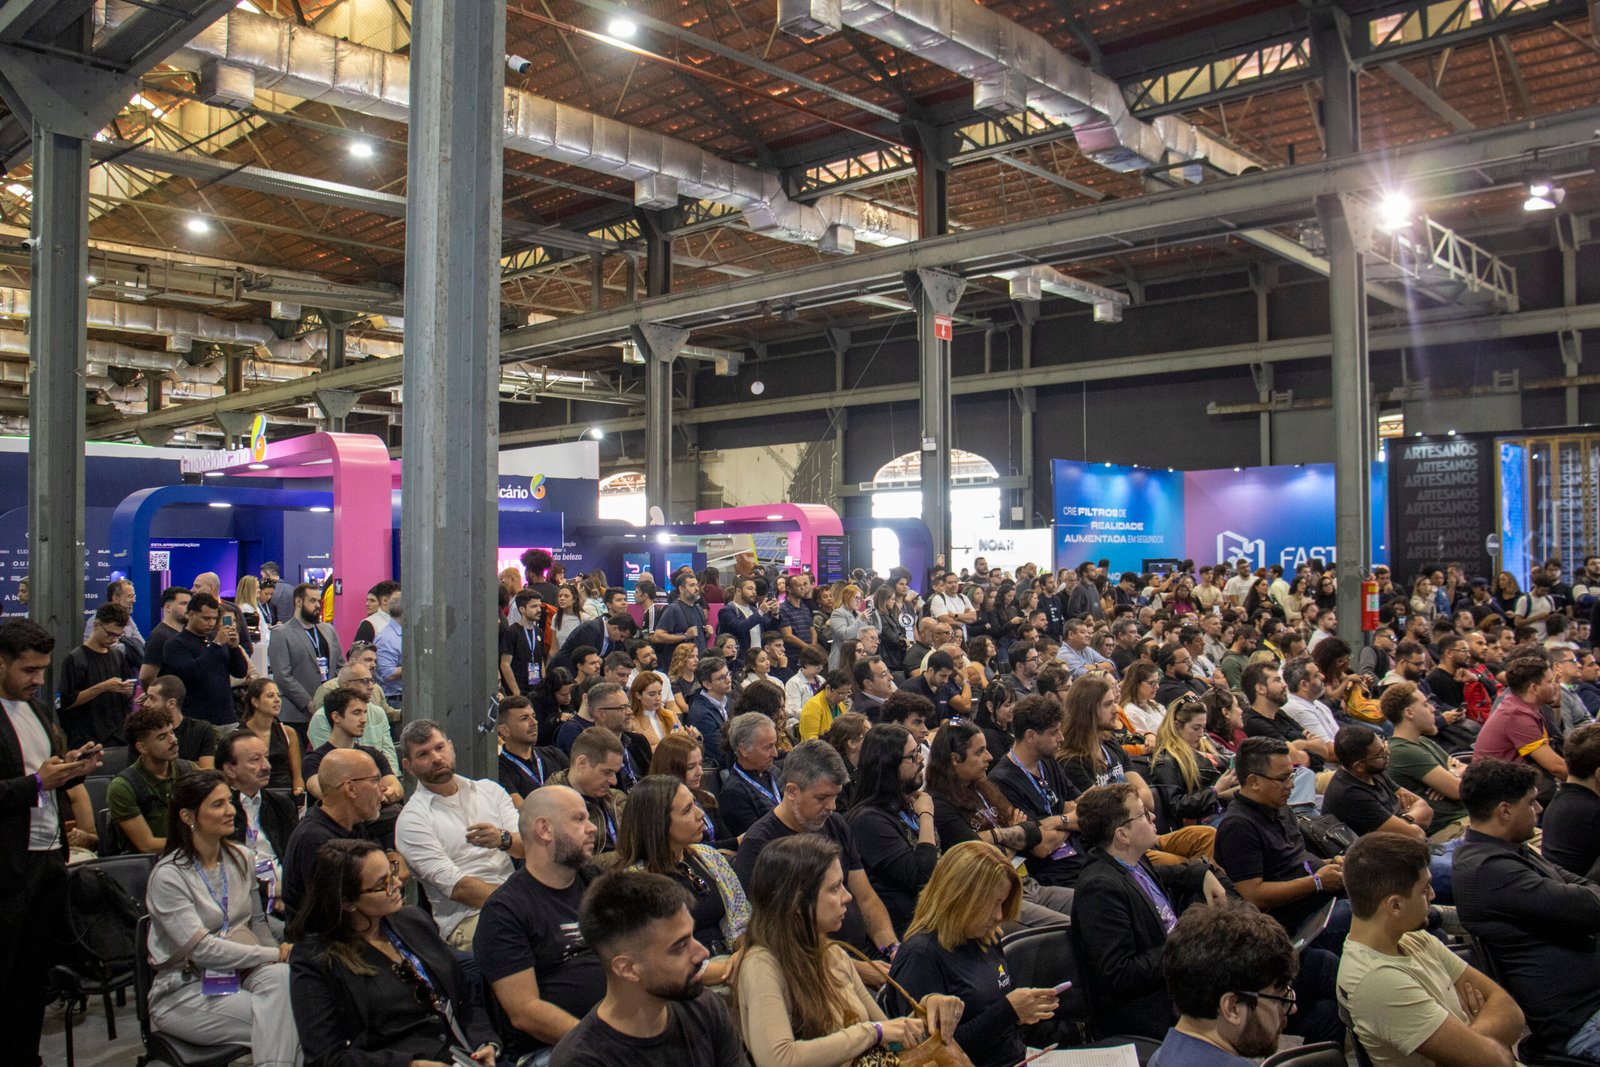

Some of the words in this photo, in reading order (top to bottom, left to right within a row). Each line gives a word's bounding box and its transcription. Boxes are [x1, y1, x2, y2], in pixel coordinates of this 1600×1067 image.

[1404, 443, 1478, 459] ARTESANOS
[1416, 459, 1478, 473] ARTESANOS
[1404, 472, 1478, 488] ARTESANOS
[1417, 487, 1479, 501] ARTESANOS
[1063, 506, 1077, 516] CRIE
[1078, 507, 1118, 517] FILTROS
[1119, 509, 1127, 518] DE
[1405, 501, 1479, 515] ARTESANOS
[1091, 521, 1144, 531] REALIDADE
[1417, 516, 1480, 529] ARTESANOS
[1064, 534, 1126, 543] AUMENTADA
[1128, 535, 1136, 543] EM
